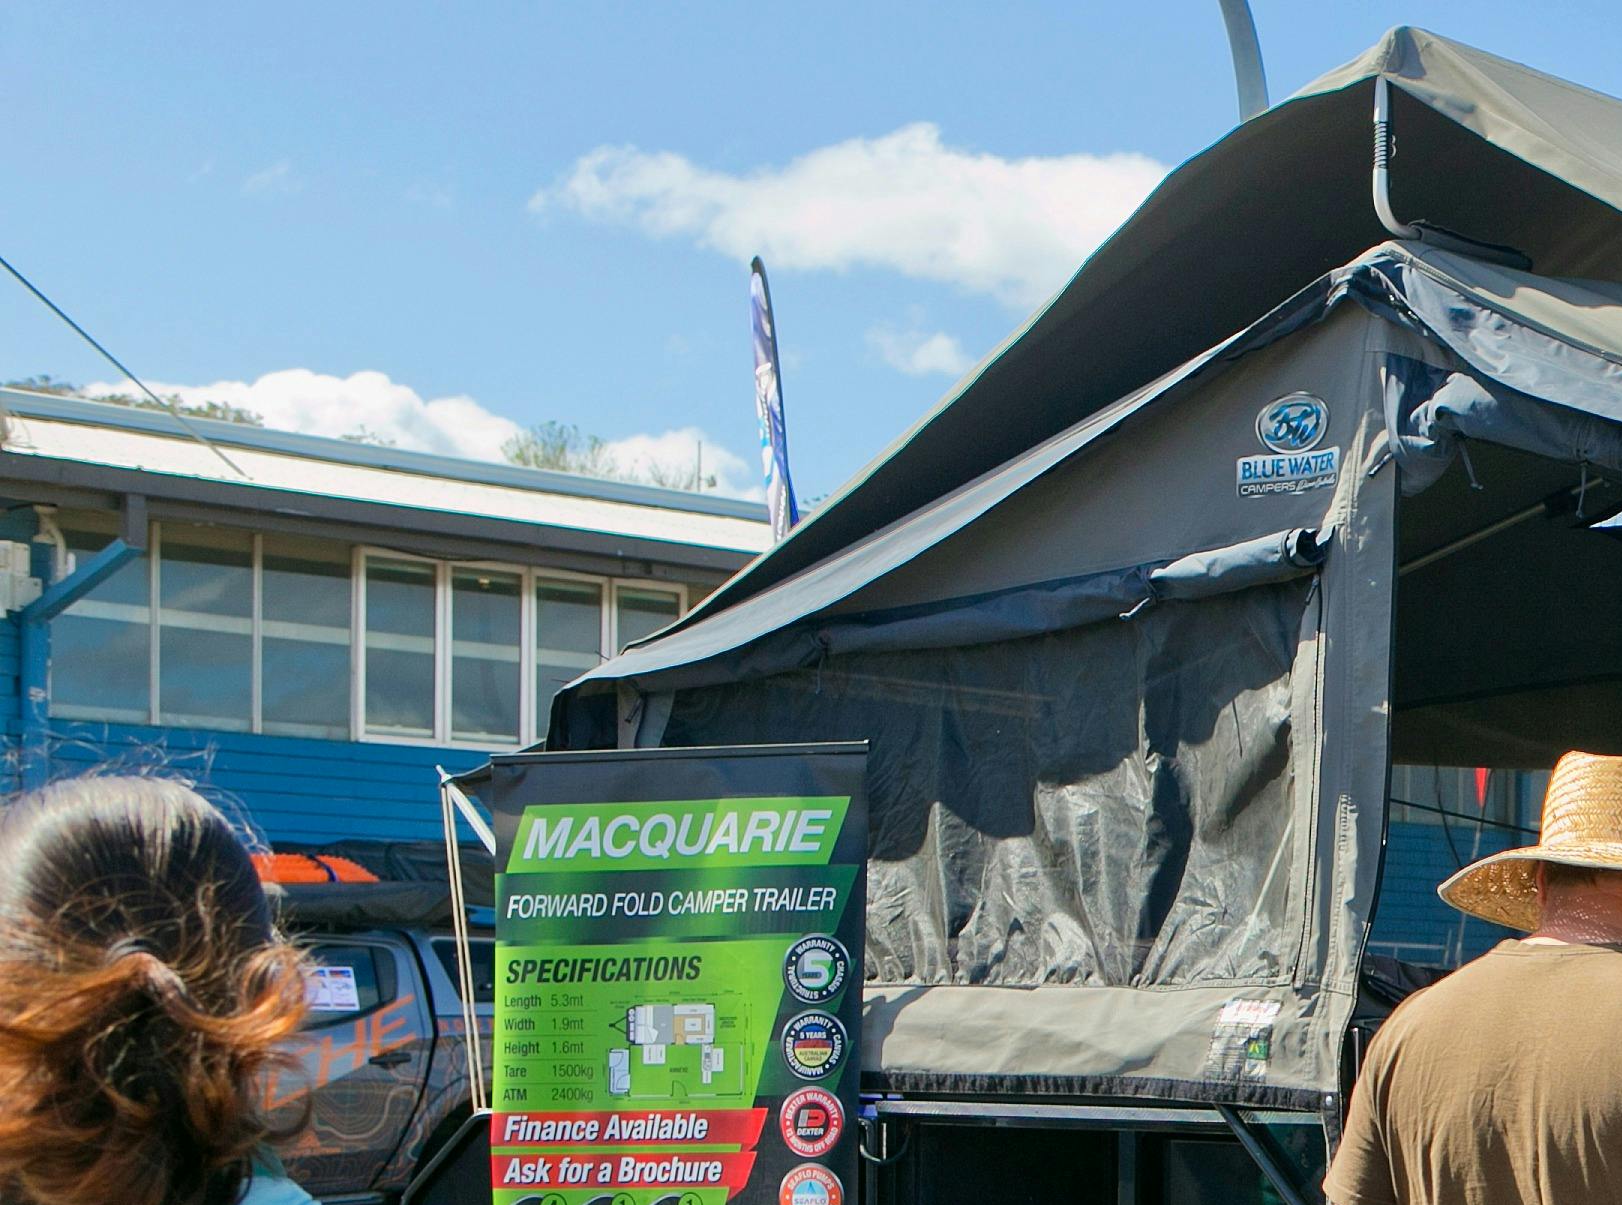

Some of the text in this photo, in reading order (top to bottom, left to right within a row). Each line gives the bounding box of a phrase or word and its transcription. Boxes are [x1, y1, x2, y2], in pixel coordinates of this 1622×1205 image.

[1241, 451, 1334, 481] BLUE WATER
[1240, 481, 1297, 496] CAMPERS
[522, 809, 833, 860] MACQUARIE
[506, 887, 837, 920] FORWARD FOLD CAMPER TRAILER
[795, 940, 836, 955] WARRANTY
[506, 955, 702, 984] SPECIFICATIONS
[798, 949, 834, 988] 5
[828, 961, 845, 992] CHASSIS
[504, 995, 584, 1009] Length 5.3mt
[504, 1018, 535, 1031] Width
[552, 1018, 584, 1031] 1.9mt
[793, 1016, 833, 1031] WARRANTY
[805, 1031, 827, 1039] YEARS
[504, 1042, 540, 1056] Height
[829, 1034, 842, 1064] CANVAS
[504, 1065, 594, 1079] Tare 1500kg
[503, 1088, 594, 1103] ATM 2400kg
[785, 1092, 839, 1119] DEXTER WARRANTY
[503, 1113, 708, 1142] Finance Available
[796, 1127, 825, 1136] DEXTER
[785, 1127, 839, 1152] 12 MONTHS OFF ROAD
[503, 1156, 723, 1184] Ask for a Brochure
[787, 1169, 835, 1190] SEAFLO PUMPS
